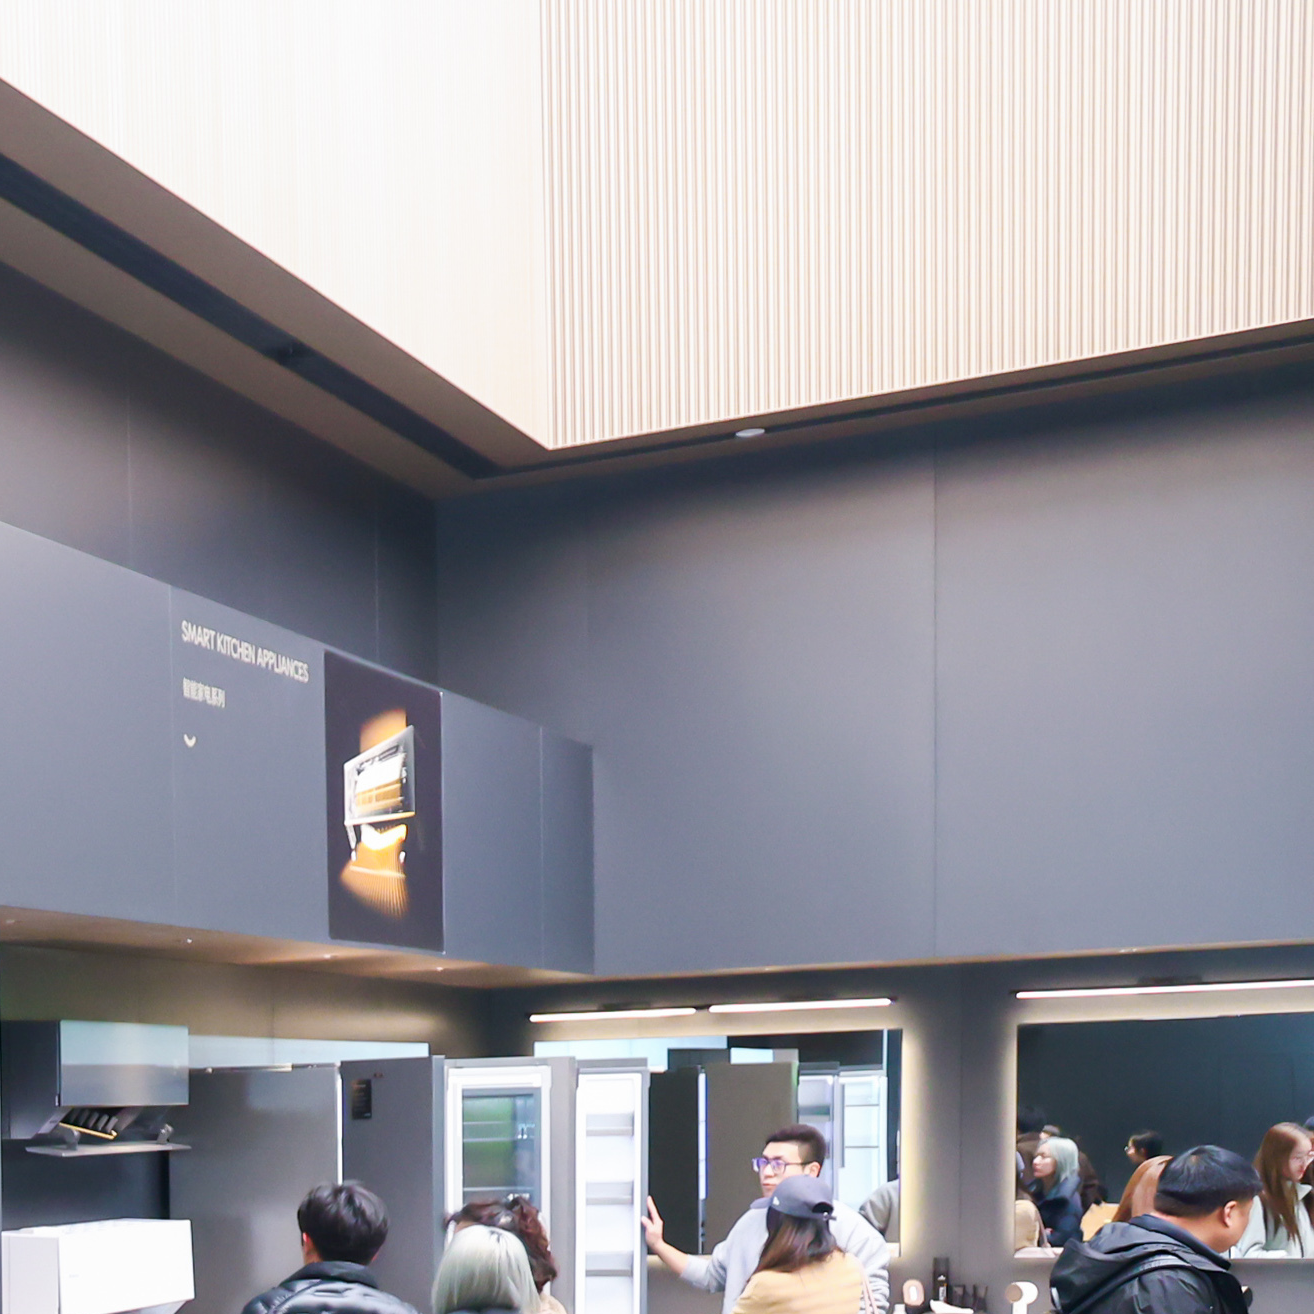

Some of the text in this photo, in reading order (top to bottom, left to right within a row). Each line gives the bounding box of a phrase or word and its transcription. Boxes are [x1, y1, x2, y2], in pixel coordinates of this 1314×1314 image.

[181, 619, 309, 684] SMART KITCHEN APPLIANCES
